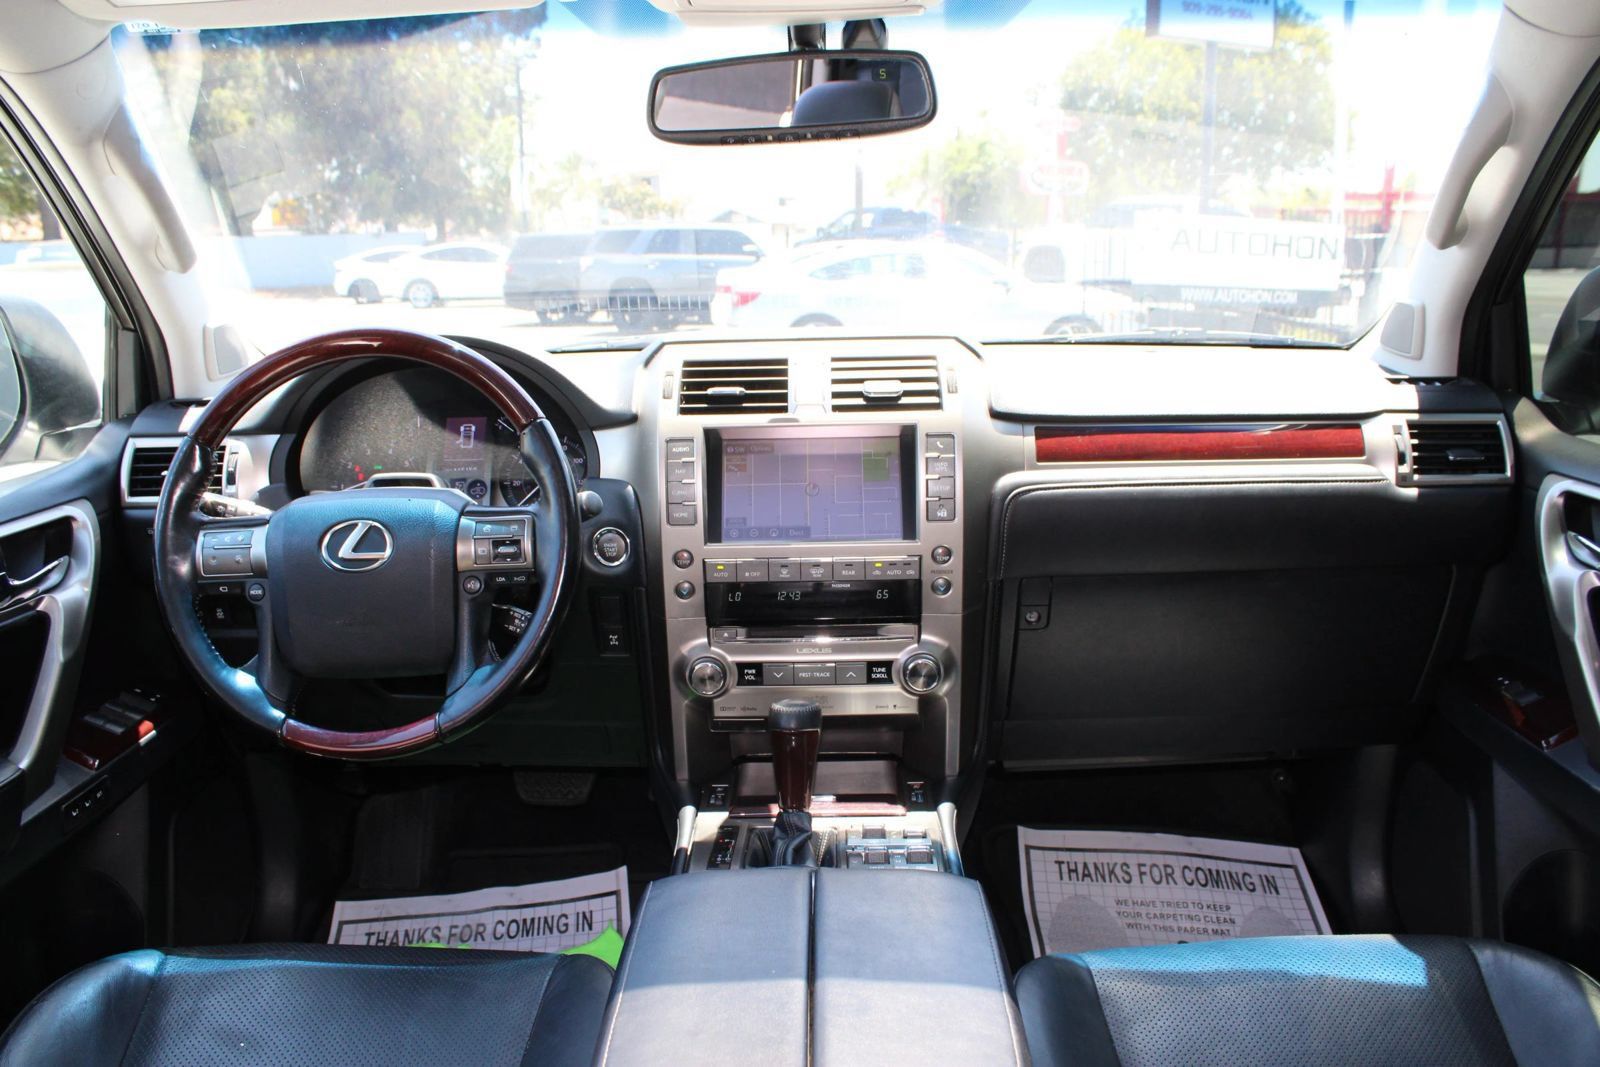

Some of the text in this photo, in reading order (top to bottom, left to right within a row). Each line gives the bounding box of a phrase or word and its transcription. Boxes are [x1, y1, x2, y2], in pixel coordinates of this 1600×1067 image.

[1169, 228, 1339, 261] AUTOHON
[1180, 286, 1298, 304] WWW.AUTOHON.COM
[876, 589, 889, 599] 65
[1055, 860, 1280, 896] THANKS FOR COMING IN
[1115, 899, 1231, 912] WE HAVE TRIED TO KEEP
[1116, 911, 1236, 925] YOUR CARPETING CLEAN
[365, 910, 593, 946] THANKS FOR COMING IN
[1126, 922, 1231, 936] WITH THIS PAPER MAT
